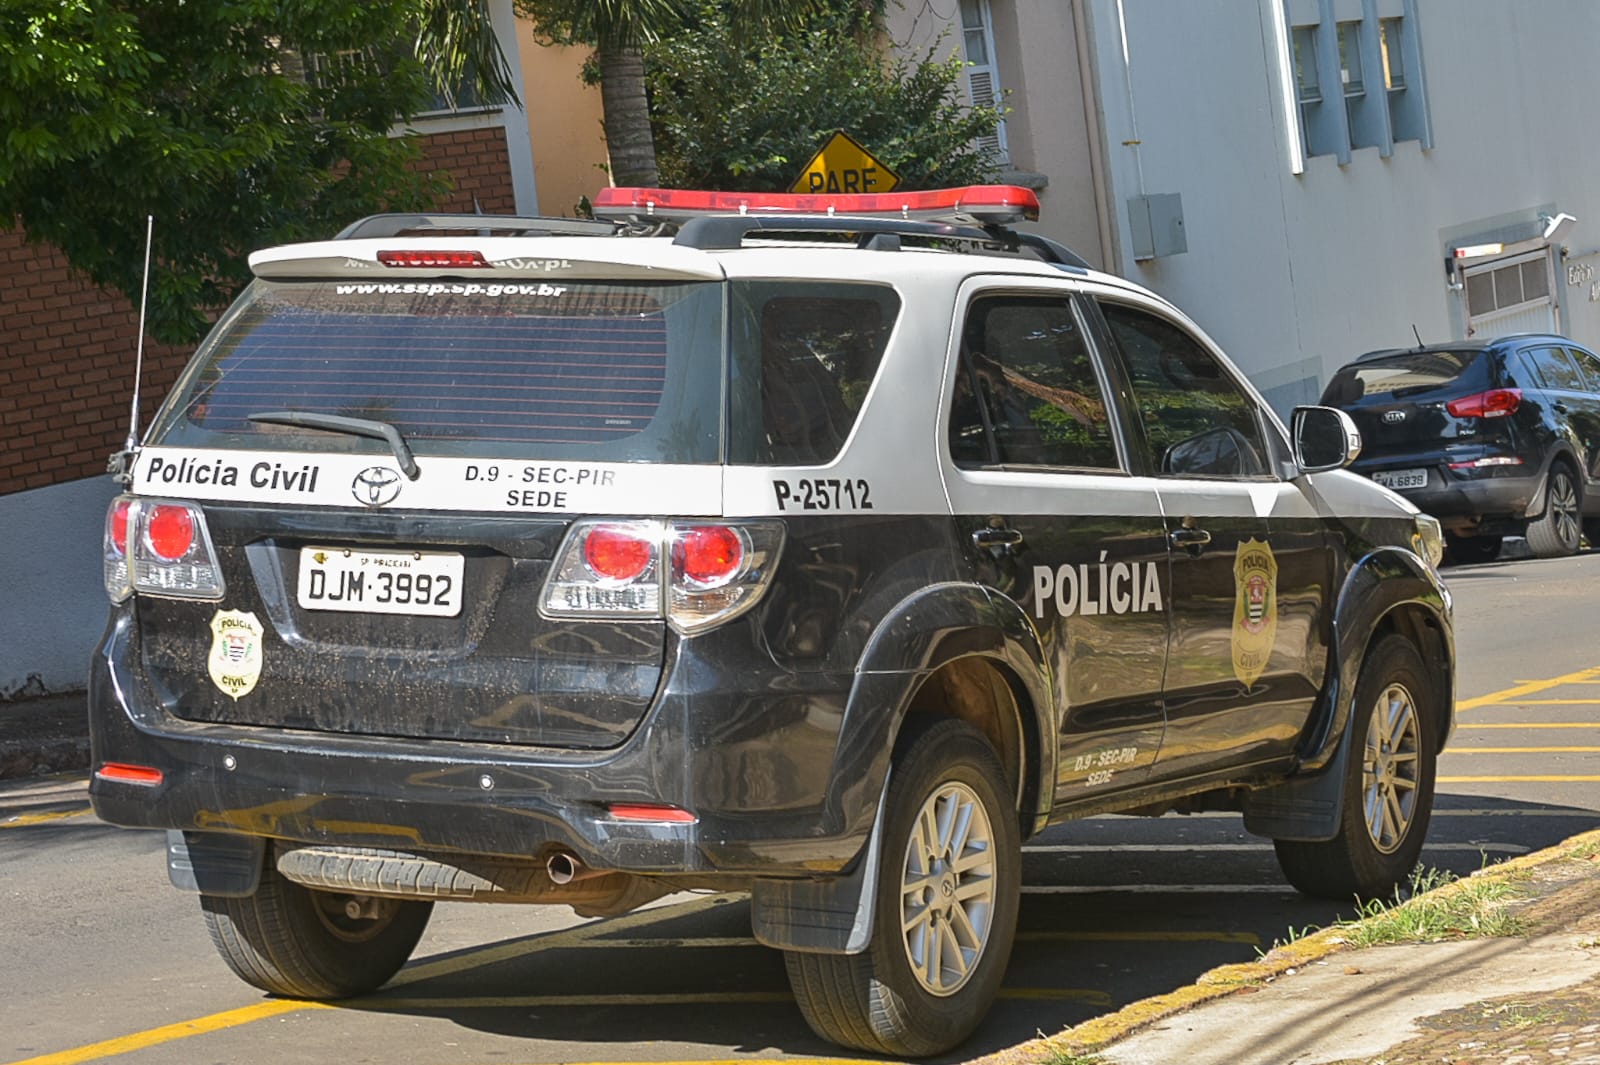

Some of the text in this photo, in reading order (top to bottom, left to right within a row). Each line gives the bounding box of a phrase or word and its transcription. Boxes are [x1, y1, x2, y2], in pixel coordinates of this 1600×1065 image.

[809, 168, 876, 193] PARE
[336, 283, 567, 297] www.ssp.sp.gov.br
[146, 457, 319, 492] Polícia Civil
[465, 466, 499, 482] D.9
[522, 467, 616, 486] SEC-PIR
[506, 490, 567, 508] SEDE
[773, 479, 873, 510] P-25712
[1033, 550, 1163, 618] POLÍCIA
[221, 675, 247, 687] CIVIL
[1074, 754, 1092, 771] D.9
[1085, 769, 1114, 787] SEDE
